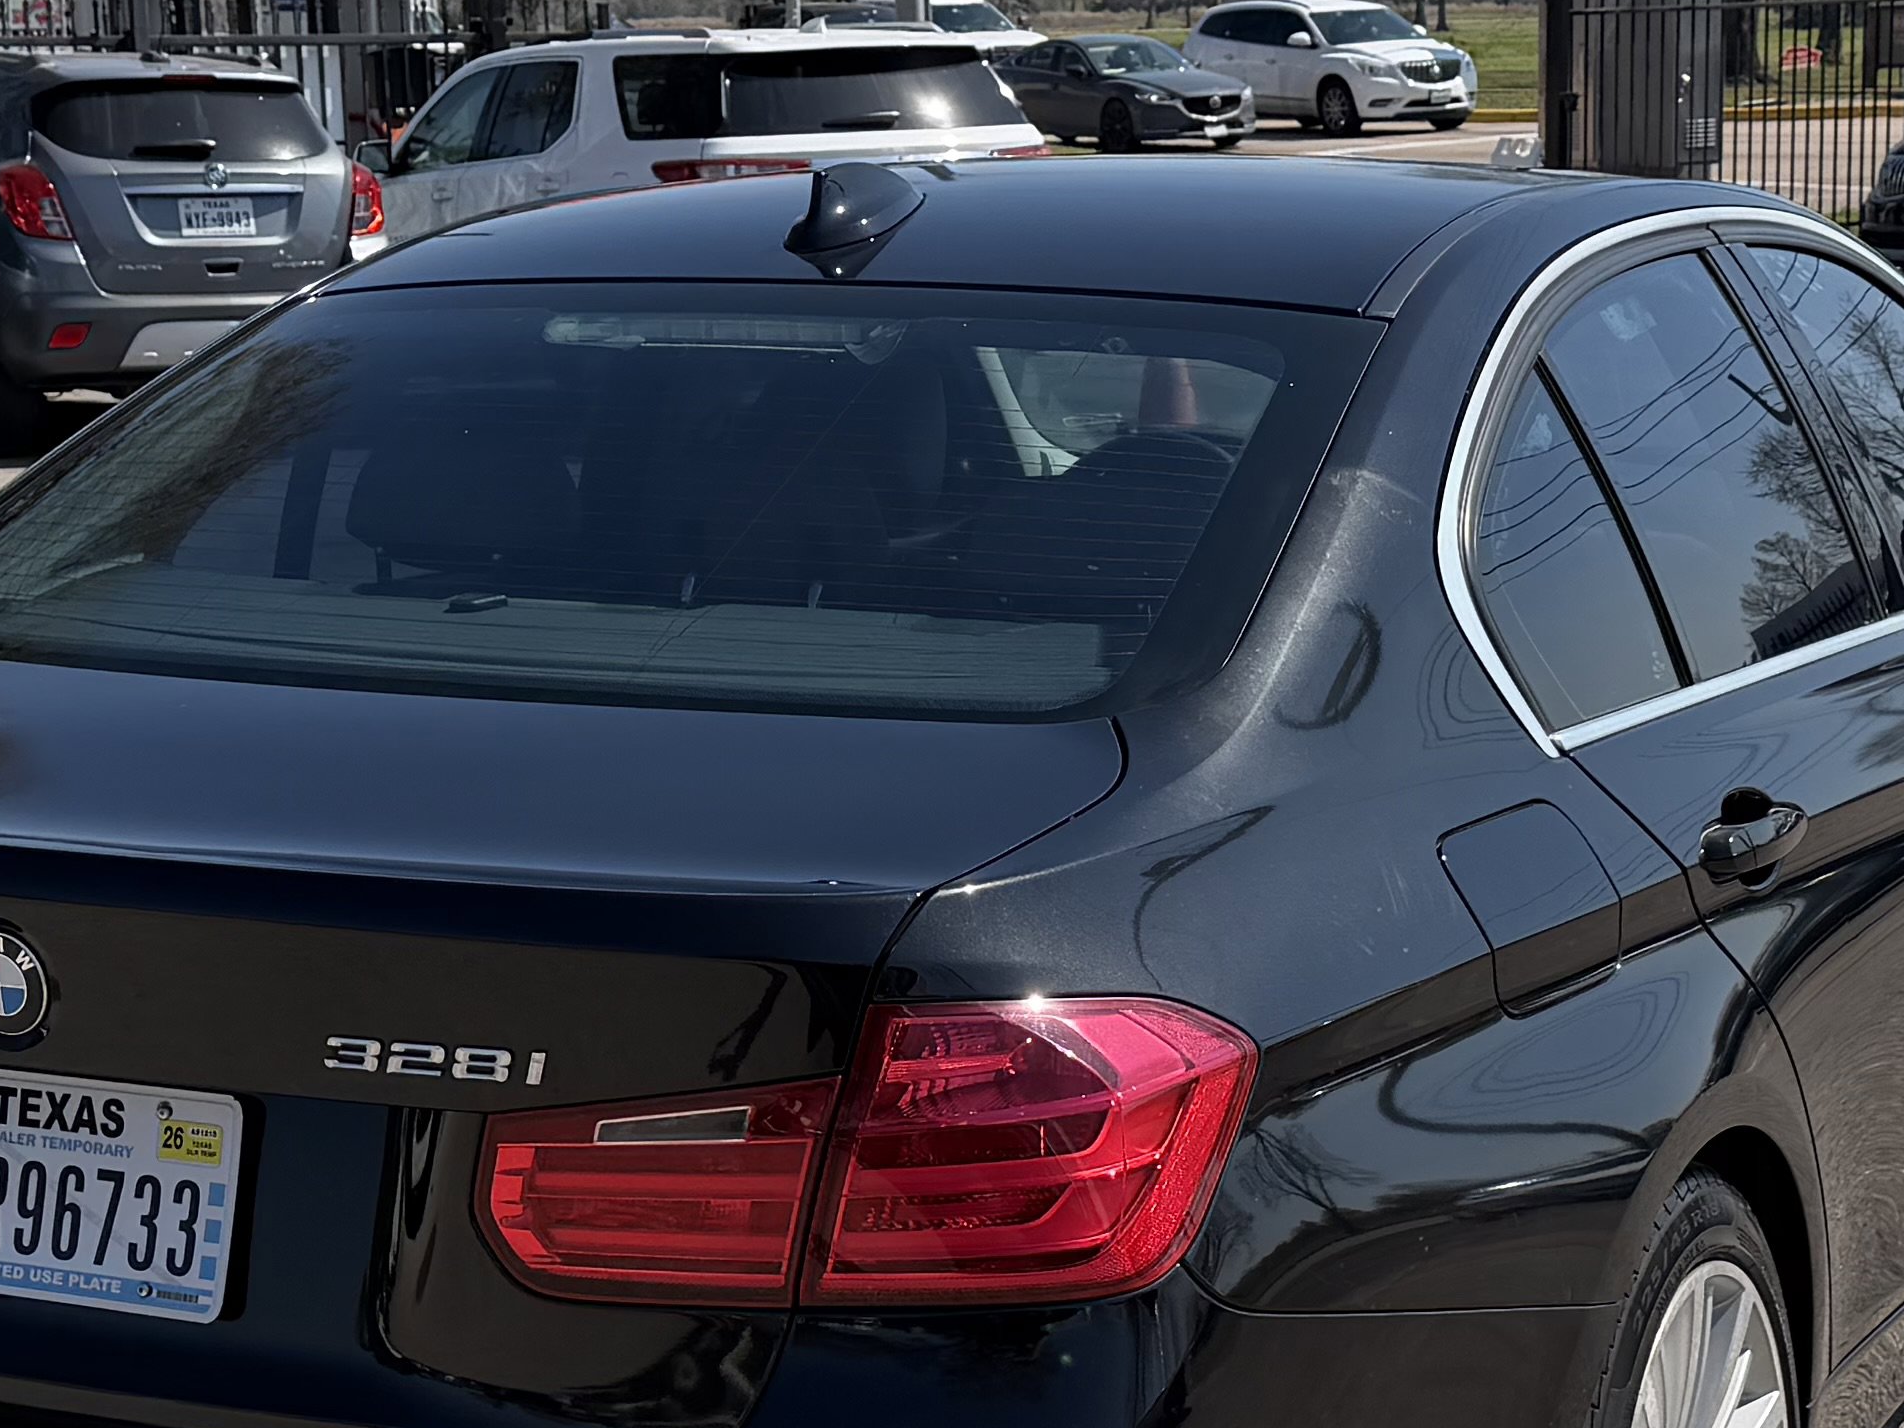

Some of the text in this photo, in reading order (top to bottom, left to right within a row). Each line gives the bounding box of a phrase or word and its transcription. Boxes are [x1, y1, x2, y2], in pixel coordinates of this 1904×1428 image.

[202, 201, 231, 209] TEXAS
[323, 1036, 547, 1085] 328i
[41, 1136, 135, 1159] TEMPORARY
[162, 1125, 185, 1150] 26
[28, 1269, 64, 1287] USE
[68, 1273, 123, 1294] PLATE
